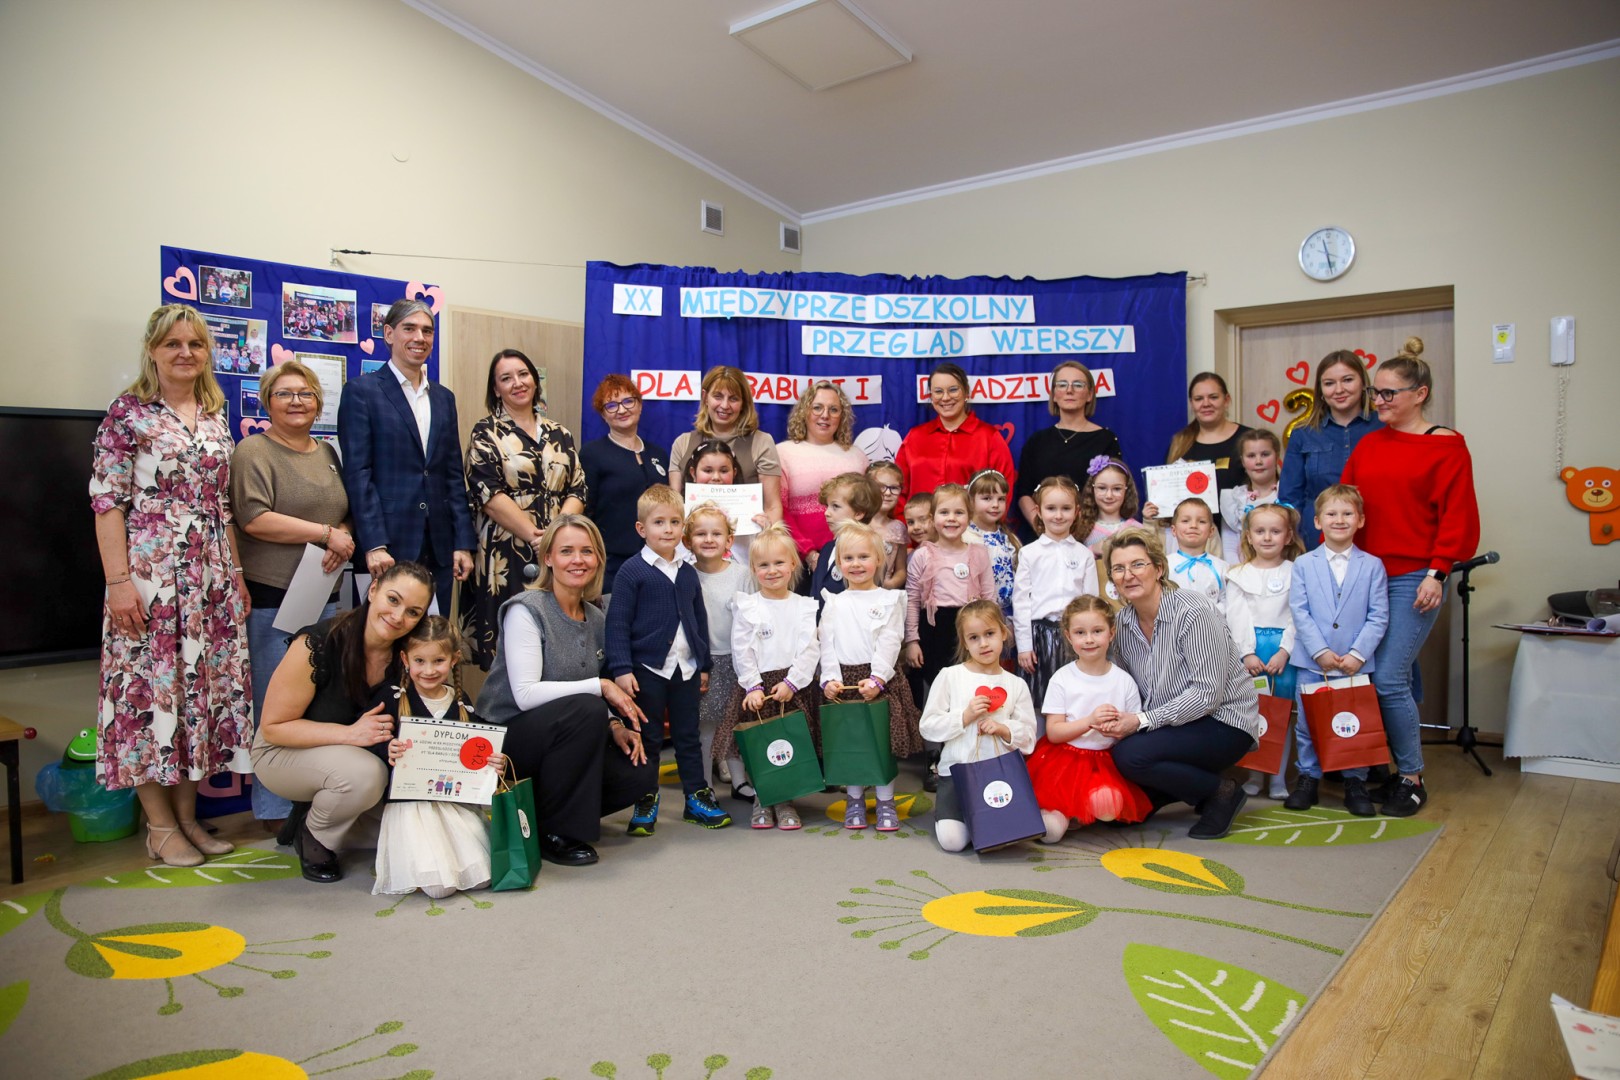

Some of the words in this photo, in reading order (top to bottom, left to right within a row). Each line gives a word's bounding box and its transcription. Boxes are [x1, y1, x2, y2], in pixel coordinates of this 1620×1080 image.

[624, 288, 653, 311] XX
[812, 329, 964, 356] PRZEGLĄD
[991, 327, 1125, 353] WIERSZY
[637, 372, 693, 397] DLA
[855, 377, 869, 400] I
[433, 730, 469, 740] DYPLOM
